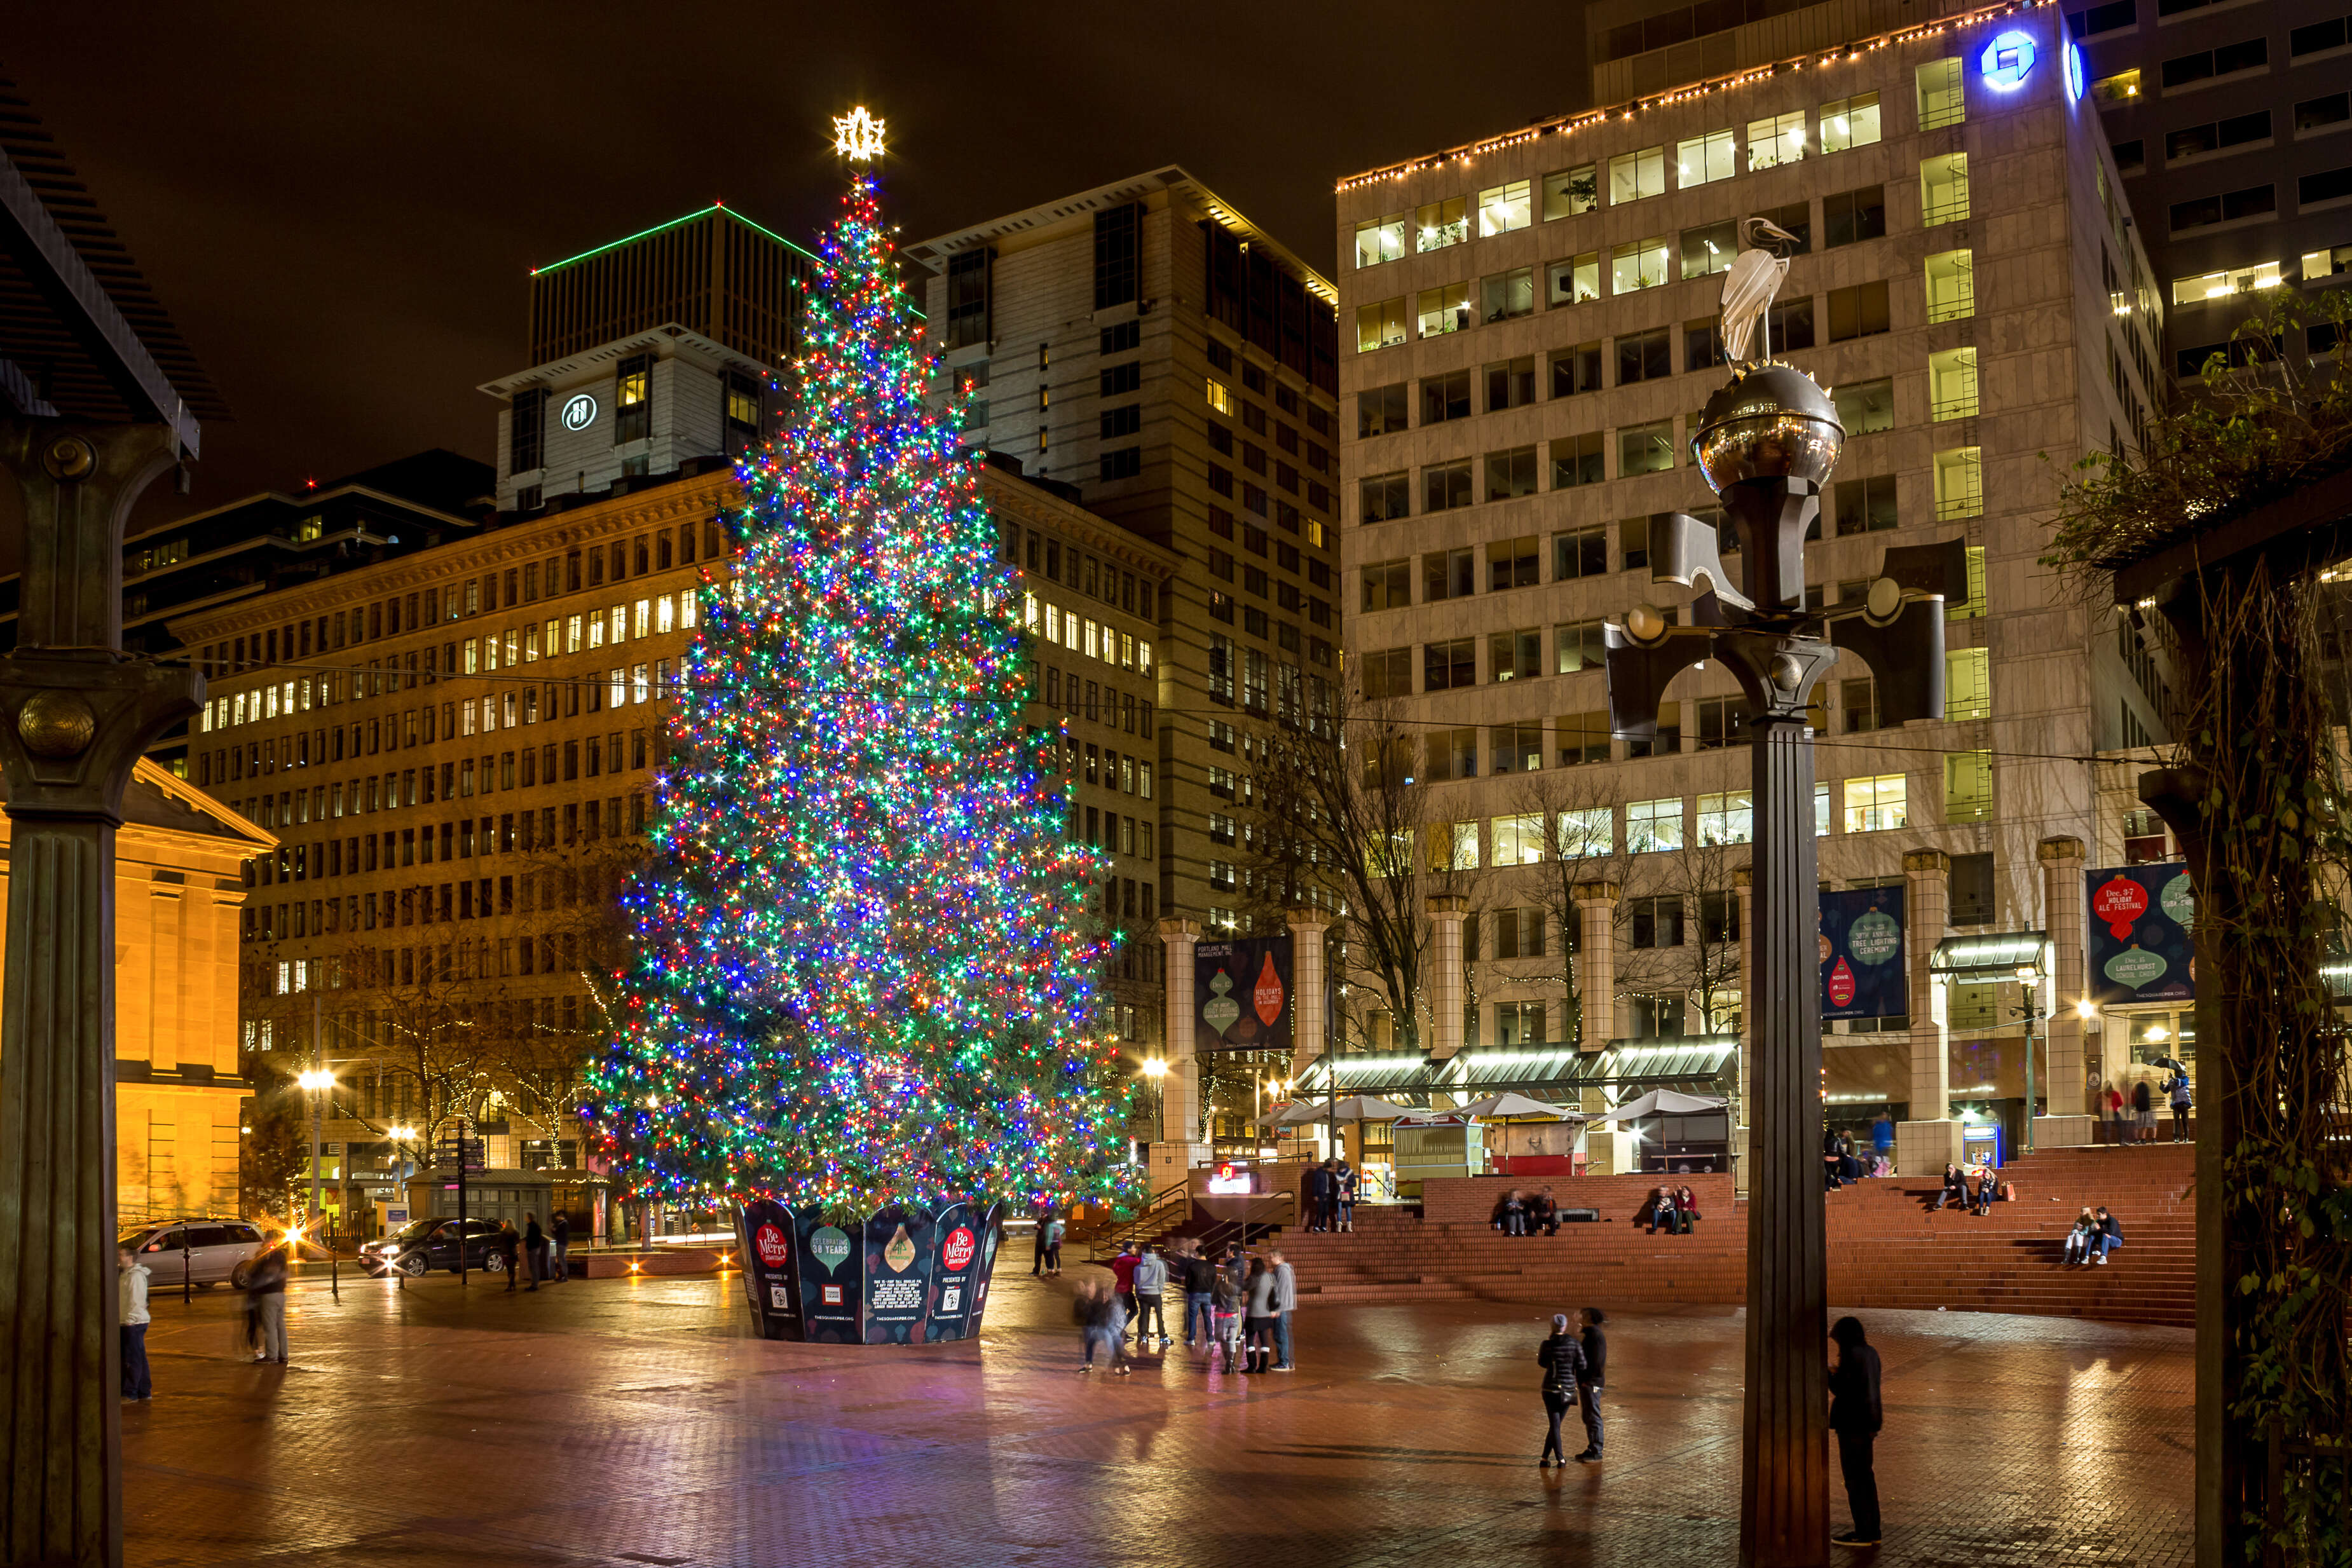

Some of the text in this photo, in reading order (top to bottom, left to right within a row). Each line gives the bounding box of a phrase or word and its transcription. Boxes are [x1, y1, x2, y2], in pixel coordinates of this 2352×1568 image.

[2114, 902, 2142, 910] FESTIVAL
[1871, 937, 1897, 946] LIGHTING
[1860, 945, 1889, 955] CEREMONY
[2116, 963, 2156, 972] LAURELHURST
[1255, 987, 1282, 996] HOLIDAYS
[765, 1228, 779, 1243] Be
[956, 1232, 968, 1246] Be
[812, 1237, 848, 1246] CELEBRATING
[758, 1239, 787, 1258] Merry
[812, 1244, 848, 1255] 30 YEARS
[945, 1243, 974, 1261] Merry
